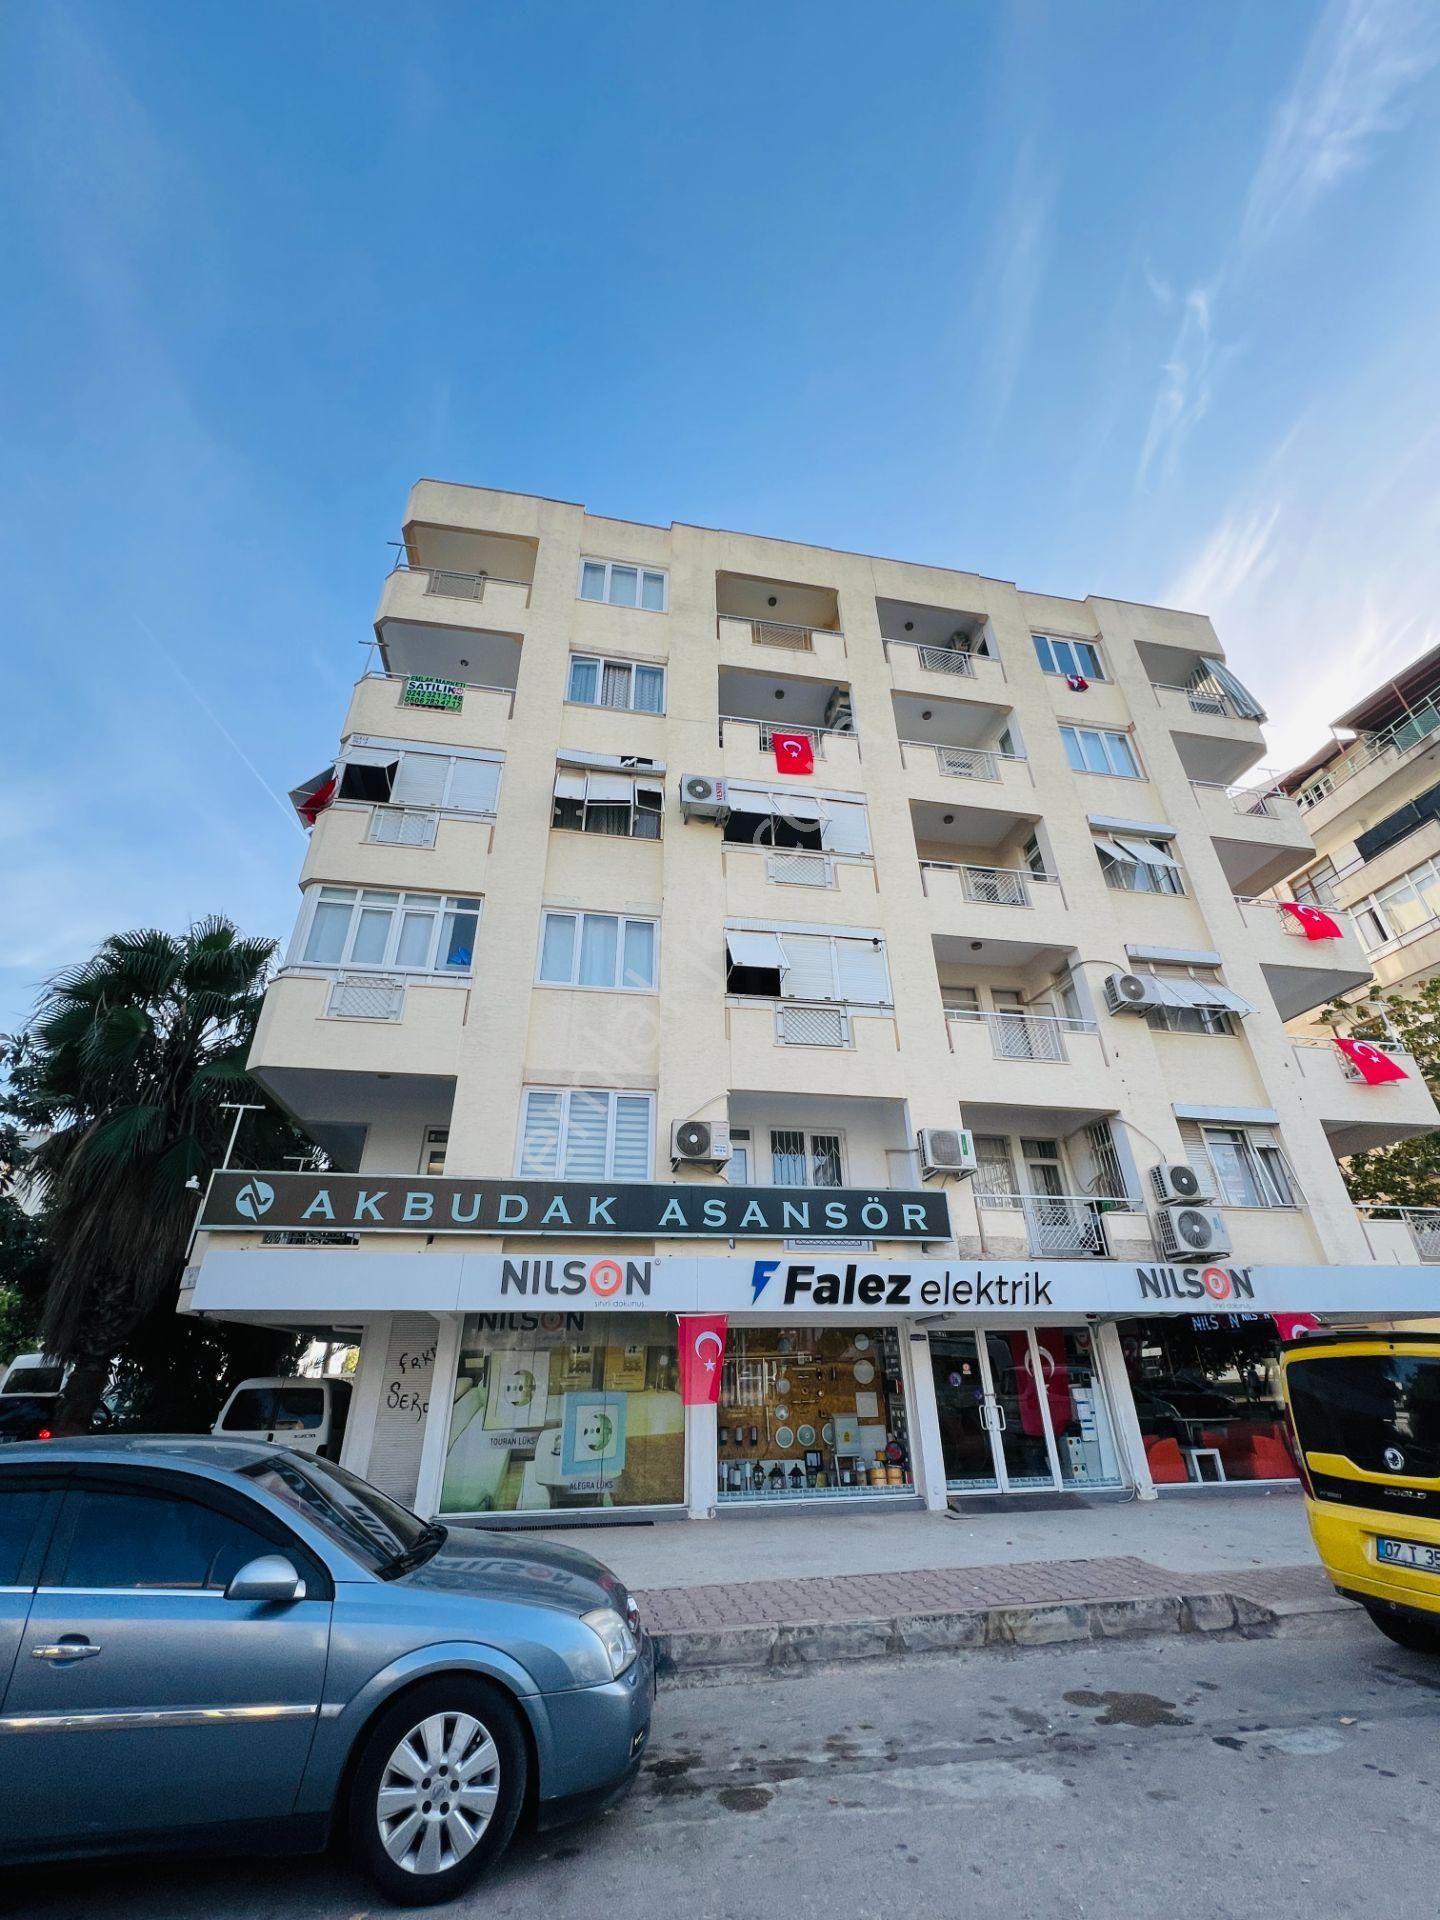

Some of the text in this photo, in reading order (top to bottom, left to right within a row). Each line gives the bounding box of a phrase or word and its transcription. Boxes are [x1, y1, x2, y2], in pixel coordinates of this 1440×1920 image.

[410, 675, 433, 683] EMLAK
[301, 1190, 929, 1231] AKBUDAK ASANSÖR
[500, 1259, 651, 1296] NILSON
[783, 1264, 1053, 1305] Falez elektrik
[1136, 1267, 1255, 1299] NILSON
[1385, 1542, 1401, 1558] 07
[1408, 1546, 1417, 1562] T
